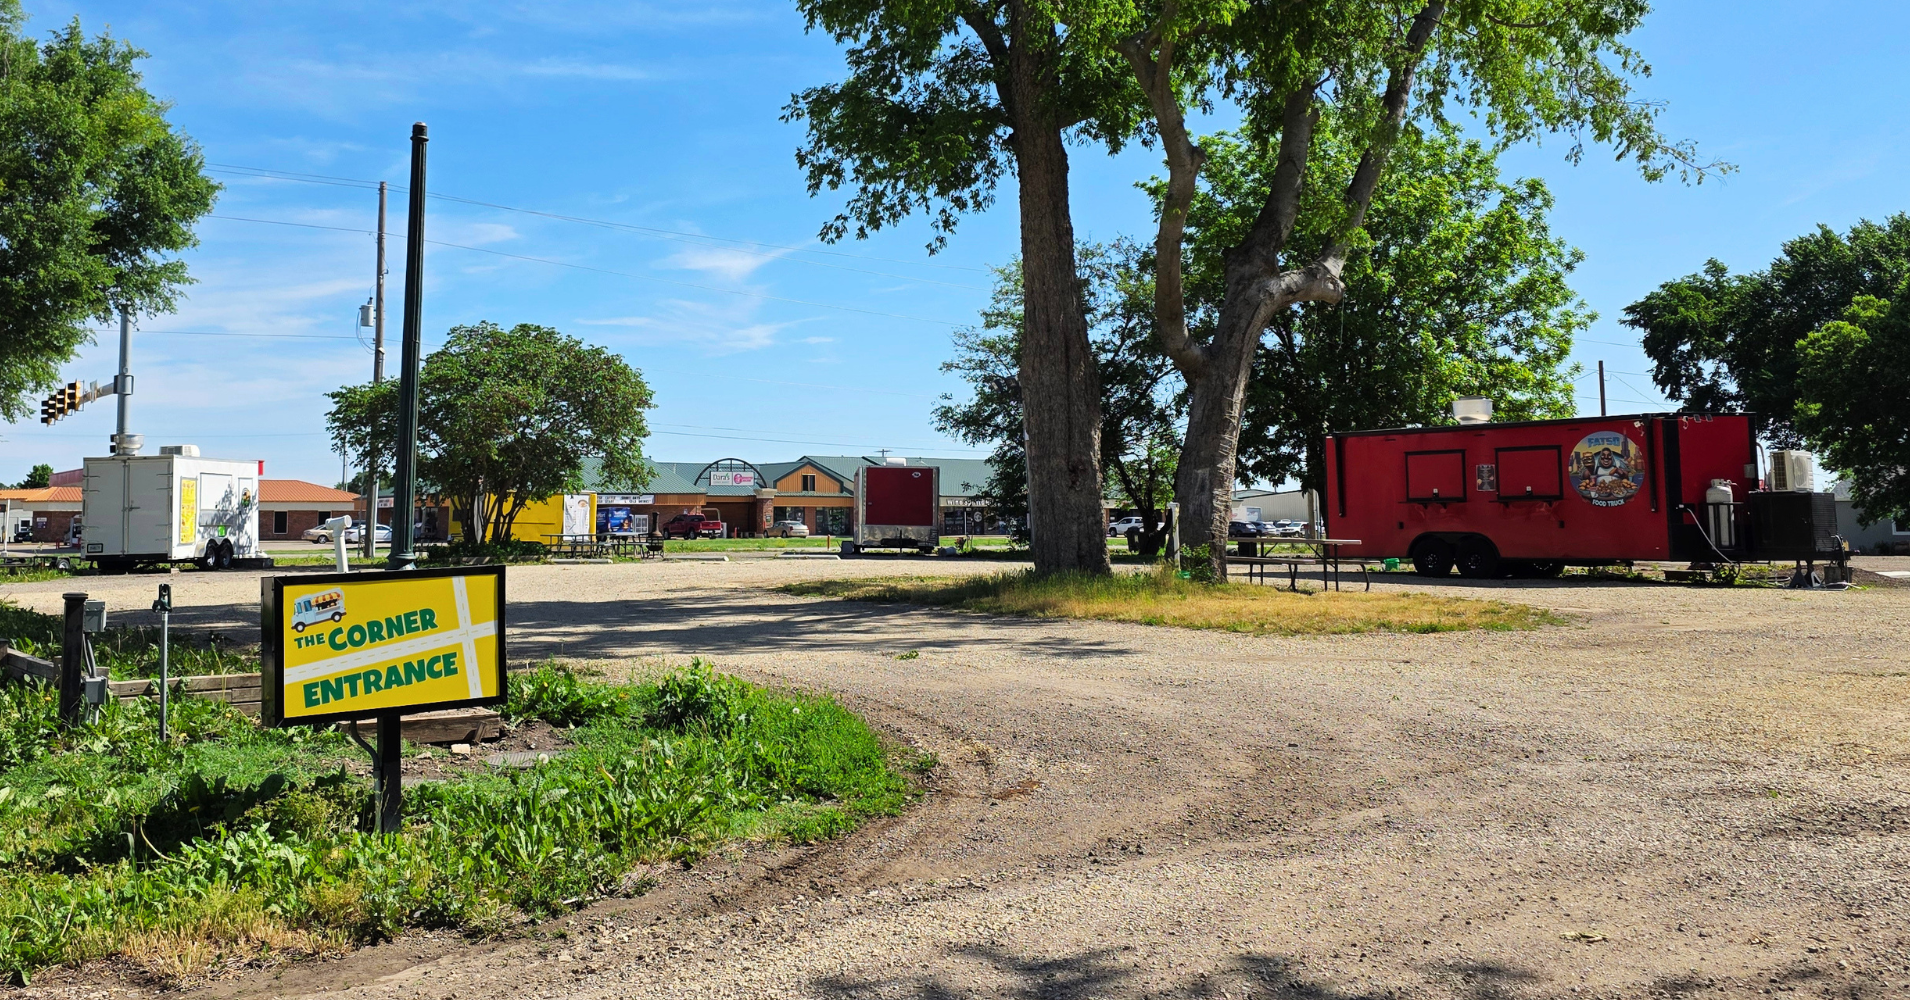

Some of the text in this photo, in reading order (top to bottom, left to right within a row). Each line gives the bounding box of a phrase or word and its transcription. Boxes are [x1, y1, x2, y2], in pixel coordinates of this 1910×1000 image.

[1587, 436, 1620, 448] FATSO
[712, 473, 730, 481] Dara's
[1592, 498, 1625, 507] FOOD TRUCK
[294, 608, 438, 651] THE CORNER
[302, 652, 459, 709] ENTRANCE
